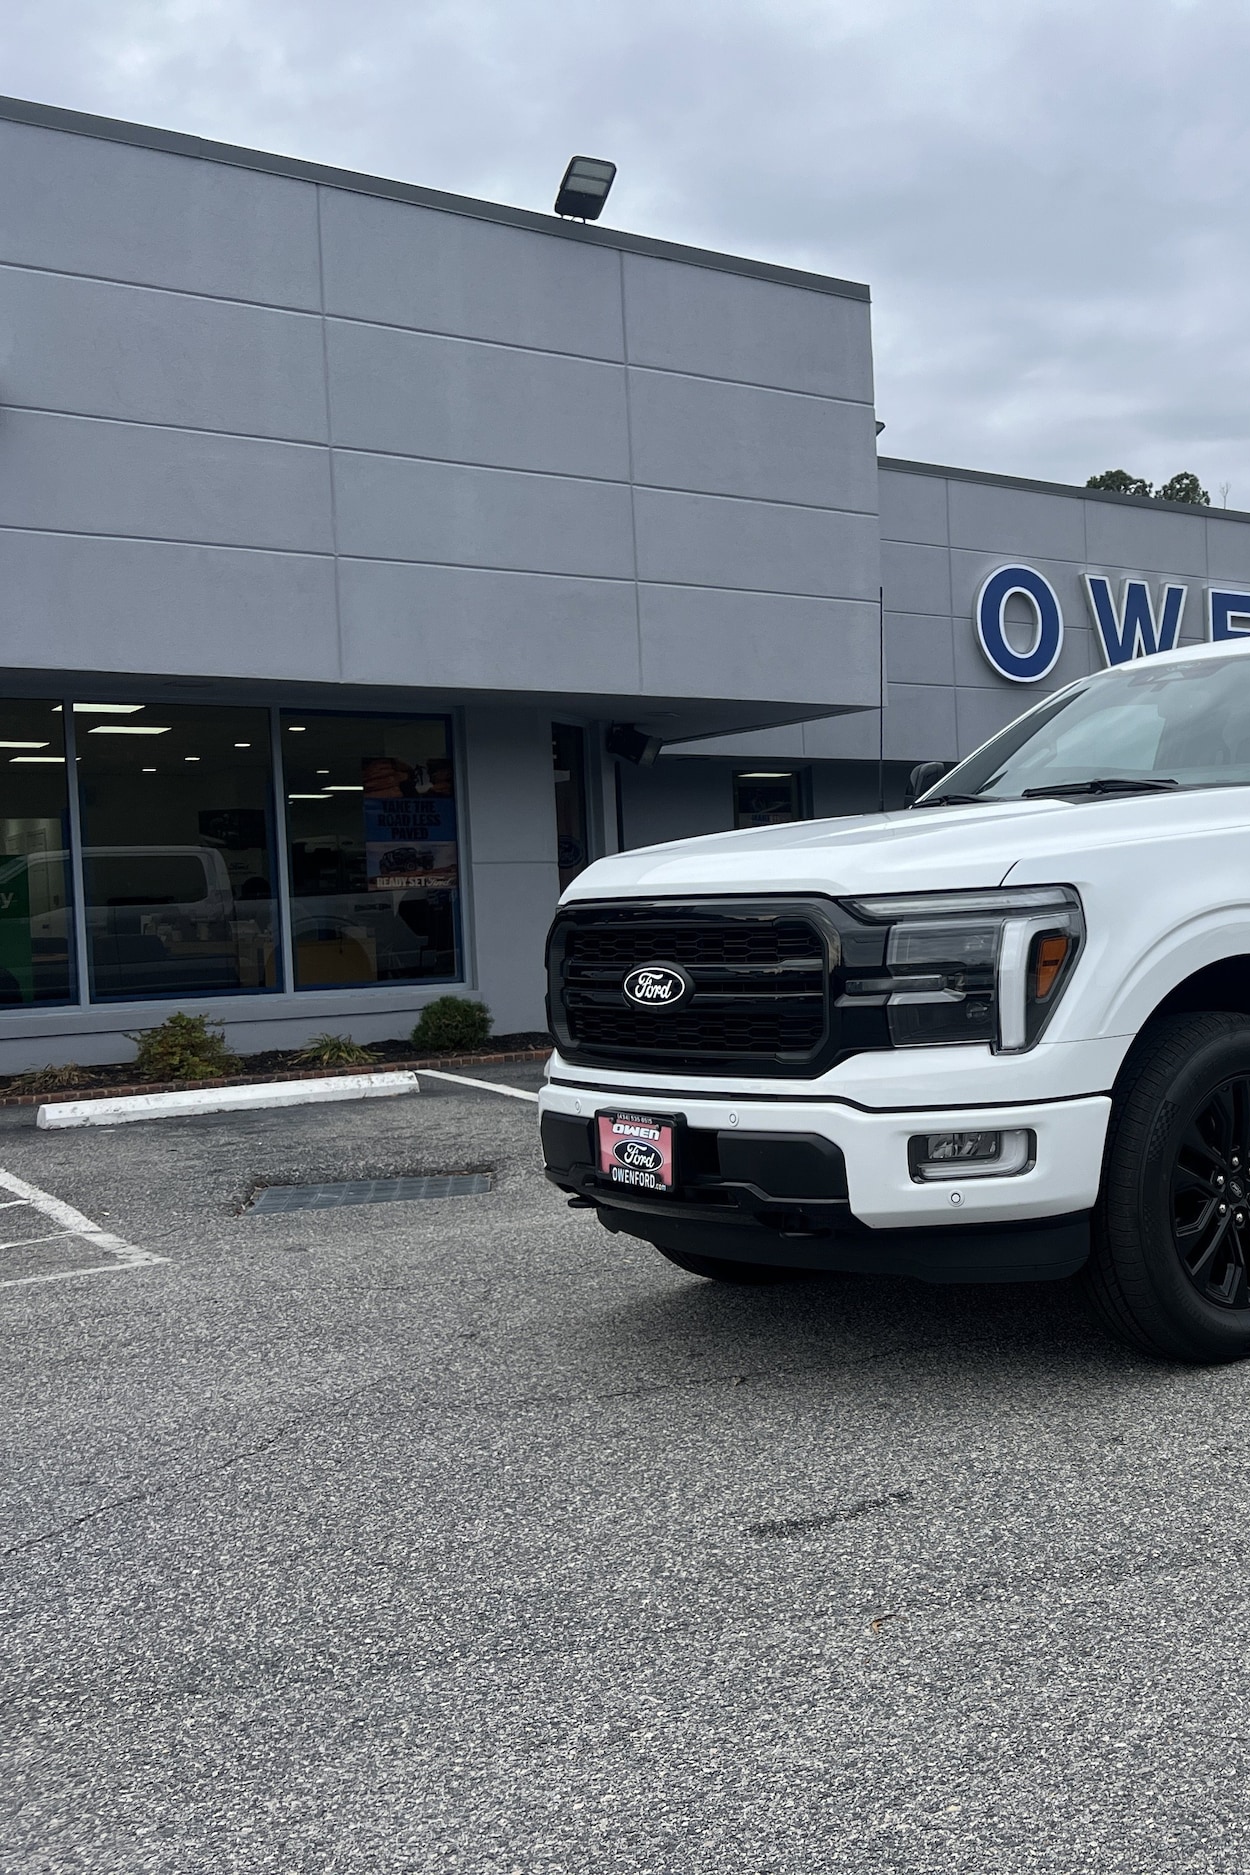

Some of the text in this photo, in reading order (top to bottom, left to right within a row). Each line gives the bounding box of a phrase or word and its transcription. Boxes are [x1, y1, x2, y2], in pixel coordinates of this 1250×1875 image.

[413, 800, 436, 813] THE
[378, 814, 441, 826] ROAD LESS
[392, 827, 429, 840] PAVED
[376, 875, 452, 888] READY SET Ford
[635, 972, 673, 999] Ford
[612, 1123, 660, 1140] OWEN
[624, 1142, 655, 1168] Ford
